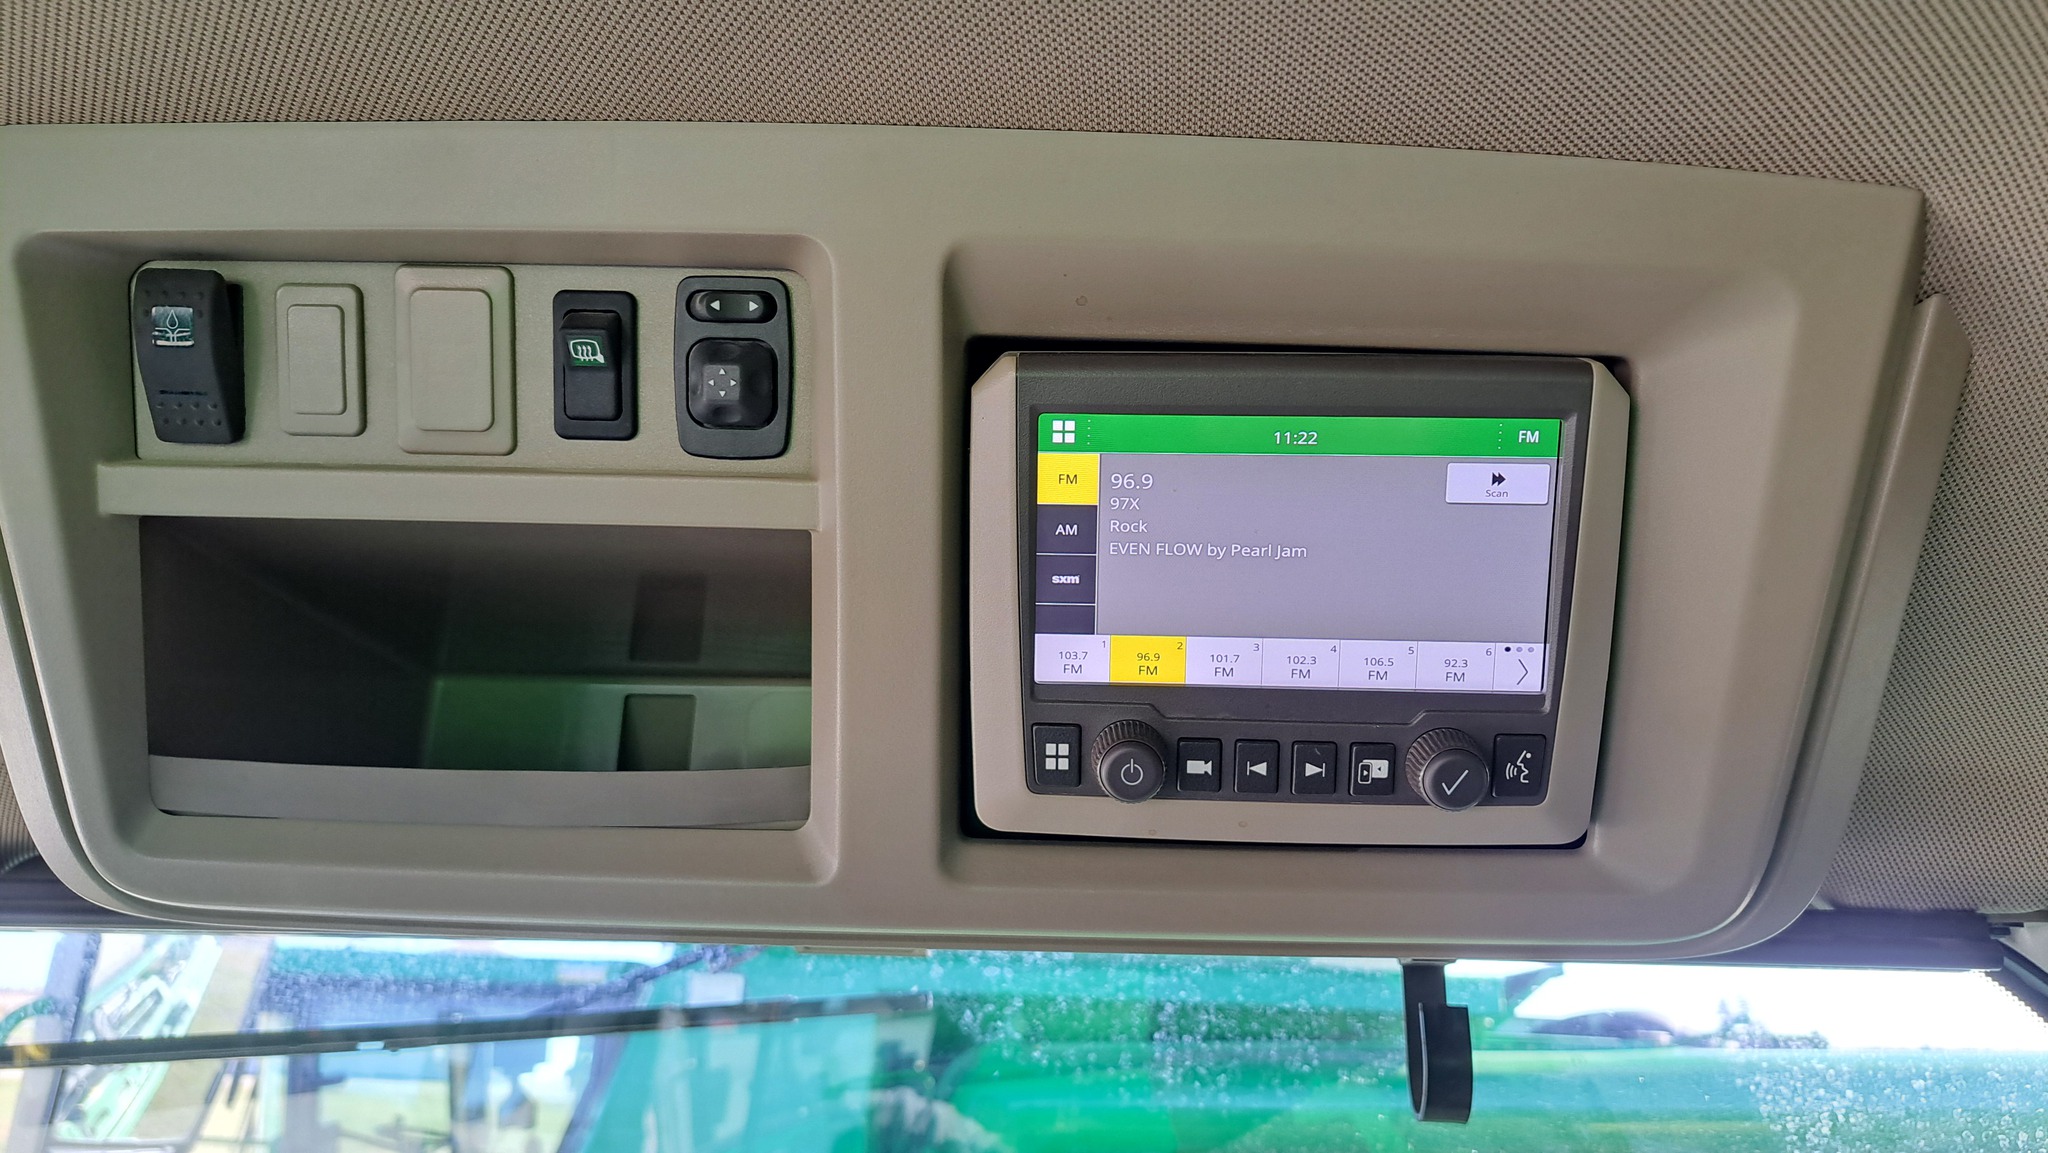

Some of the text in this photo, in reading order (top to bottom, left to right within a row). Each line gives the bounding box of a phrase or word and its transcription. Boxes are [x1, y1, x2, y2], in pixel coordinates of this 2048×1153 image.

[1273, 431, 1318, 445] 11:22
[1517, 430, 1540, 444] FM
[1057, 473, 1078, 485] FM
[1110, 473, 1154, 490] 96.9
[1485, 489, 1509, 498] Scan
[1109, 497, 1140, 510] 97X
[1055, 524, 1078, 536] AM
[1110, 520, 1148, 533] Rock
[1109, 542, 1307, 560] EVEN FLOW by Pearl Jam
[1051, 574, 1080, 584] sxm
[1101, 640, 1107, 648] 1
[1176, 641, 1184, 651] 2
[1253, 643, 1260, 652] 3
[1330, 645, 1337, 654] 4
[1407, 646, 1415, 655] 5
[1485, 648, 1493, 657] 6
[1058, 651, 1088, 660] 103.7
[1136, 652, 1161, 662] 96.9
[1209, 654, 1240, 664] 101.7
[1286, 655, 1317, 665] 102.3
[1363, 657, 1394, 667] 106.5
[1443, 658, 1468, 669] 92.3
[1063, 664, 1083, 674] FM
[1138, 665, 1158, 676] FM
[1214, 667, 1234, 677] FM
[1290, 668, 1311, 679] FM
[1368, 670, 1388, 681] FM
[1445, 671, 1466, 682] FM
